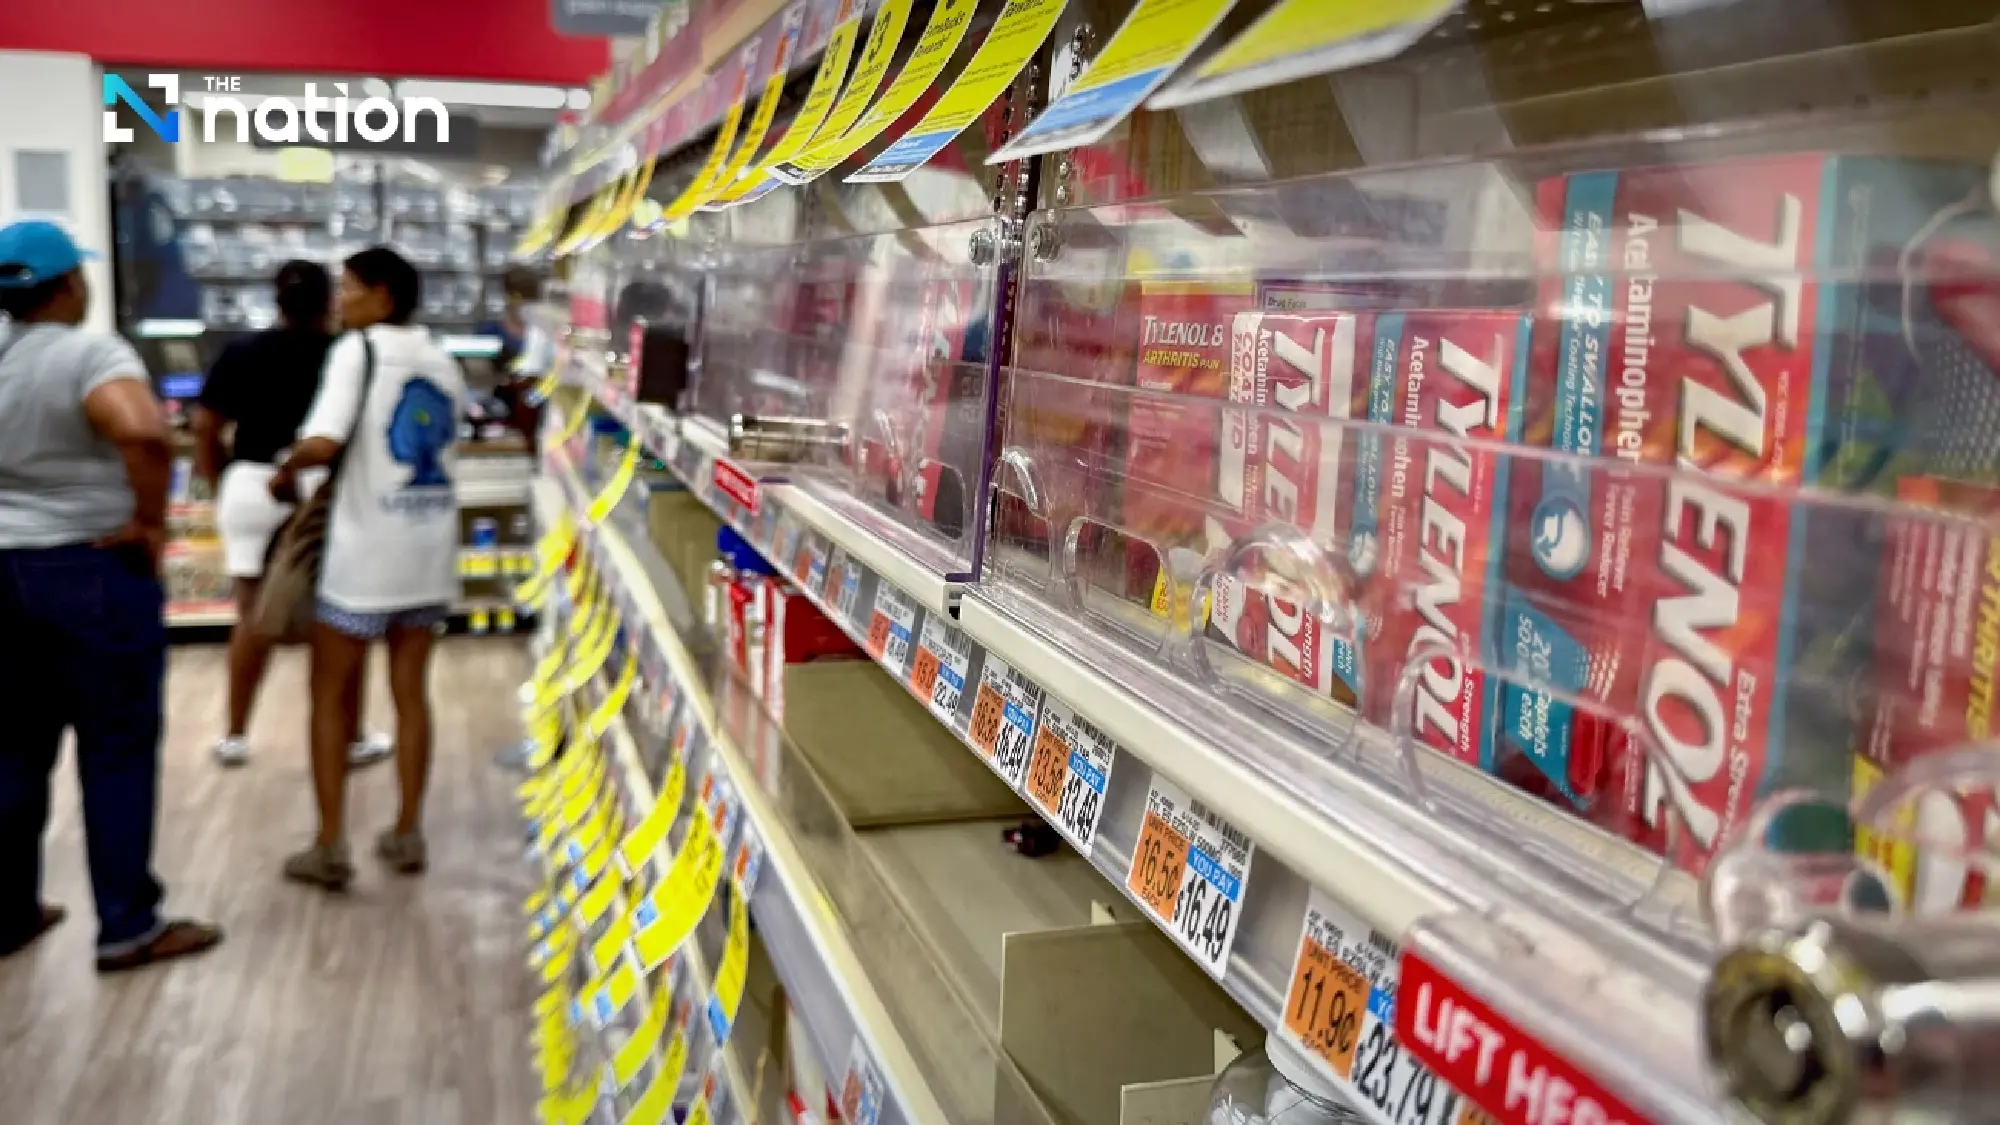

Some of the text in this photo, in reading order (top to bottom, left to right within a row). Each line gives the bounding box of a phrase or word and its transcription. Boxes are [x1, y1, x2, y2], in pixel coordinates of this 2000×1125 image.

[1143, 315, 1224, 348] TYLENOL 8
[1143, 349, 1201, 368] ARTHRITIS
[1406, 333, 1503, 745] TYLENOL
[1643, 191, 1802, 848] TYLENOL
[1460, 679, 1474, 752] Strength
[1519, 692, 1533, 741] each
[1733, 668, 1757, 742] Extra
[1057, 772, 1099, 846] $13.49
[1085, 765, 1100, 787] PAY
[1139, 834, 1181, 900] 16.5¢
[1163, 827, 1185, 853] PRICE
[1192, 852, 1212, 878] YOU
[1211, 869, 1235, 895] PAY
[1173, 872, 1232, 964] $16.49
[1296, 966, 1355, 1053] 11.9¢
[1413, 981, 1504, 1087] LIFT
